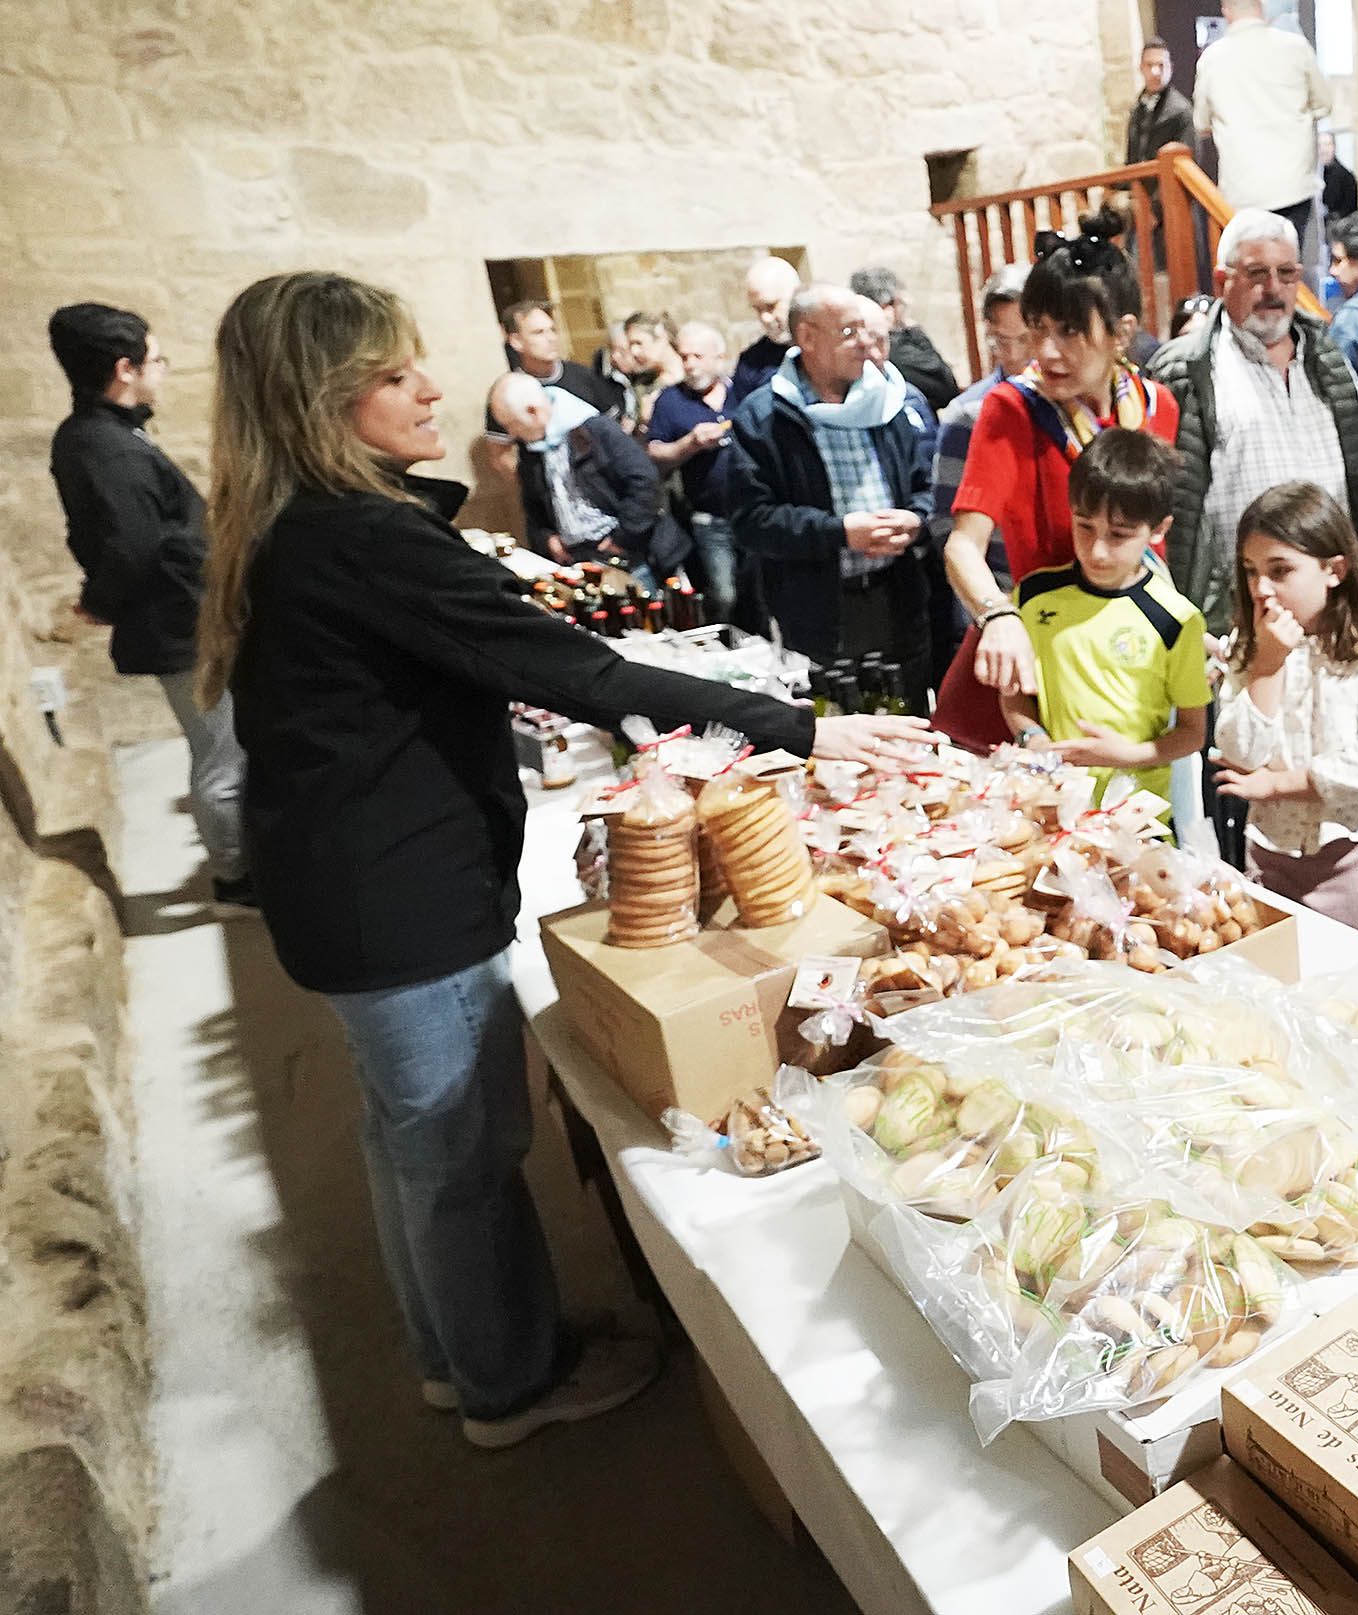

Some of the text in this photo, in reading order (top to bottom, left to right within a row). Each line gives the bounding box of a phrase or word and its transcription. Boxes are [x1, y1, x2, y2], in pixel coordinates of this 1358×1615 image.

[1264, 1387, 1316, 1430] Nata
[1316, 1426, 1343, 1453] de
[1114, 1564, 1158, 1614] Nata
